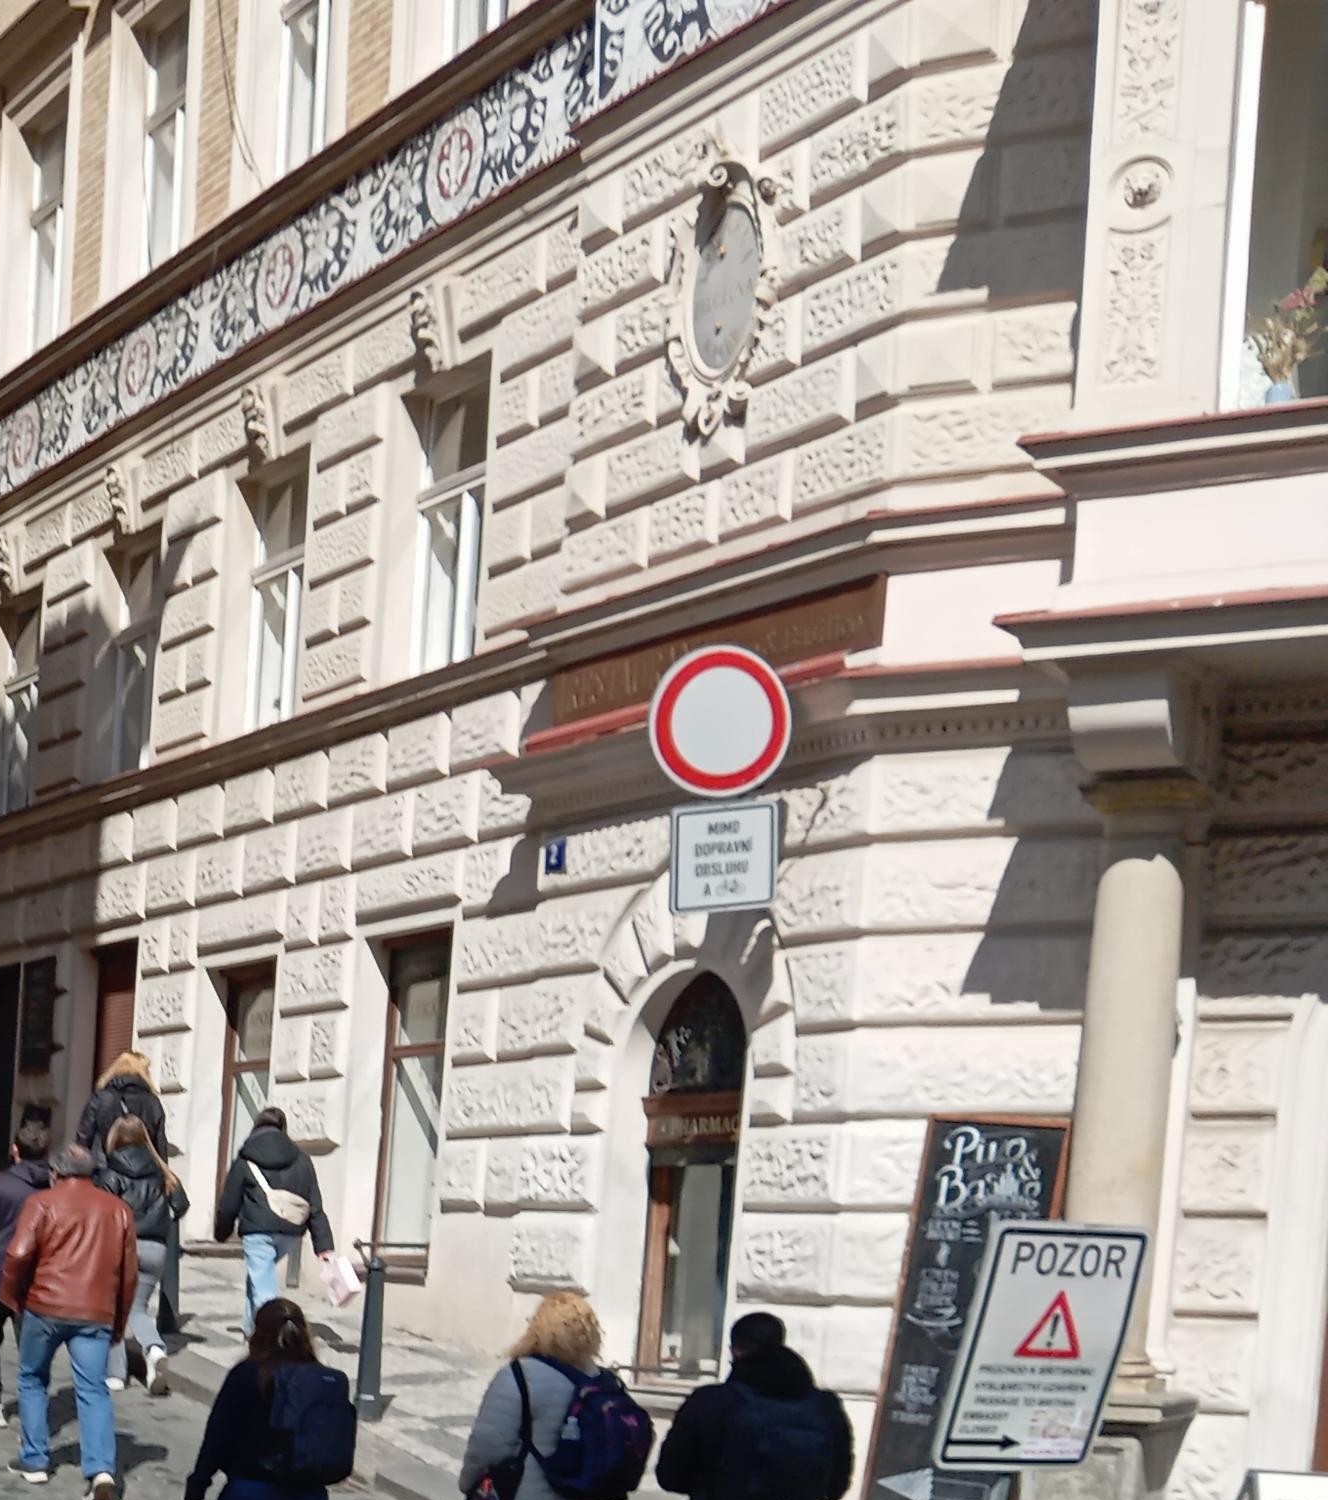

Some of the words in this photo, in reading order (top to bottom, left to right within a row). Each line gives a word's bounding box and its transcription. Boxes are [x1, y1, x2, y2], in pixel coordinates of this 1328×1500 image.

[707, 821, 741, 835] MIMO
[703, 882, 712, 896] A
[1011, 1242, 1127, 1279] POZOR
